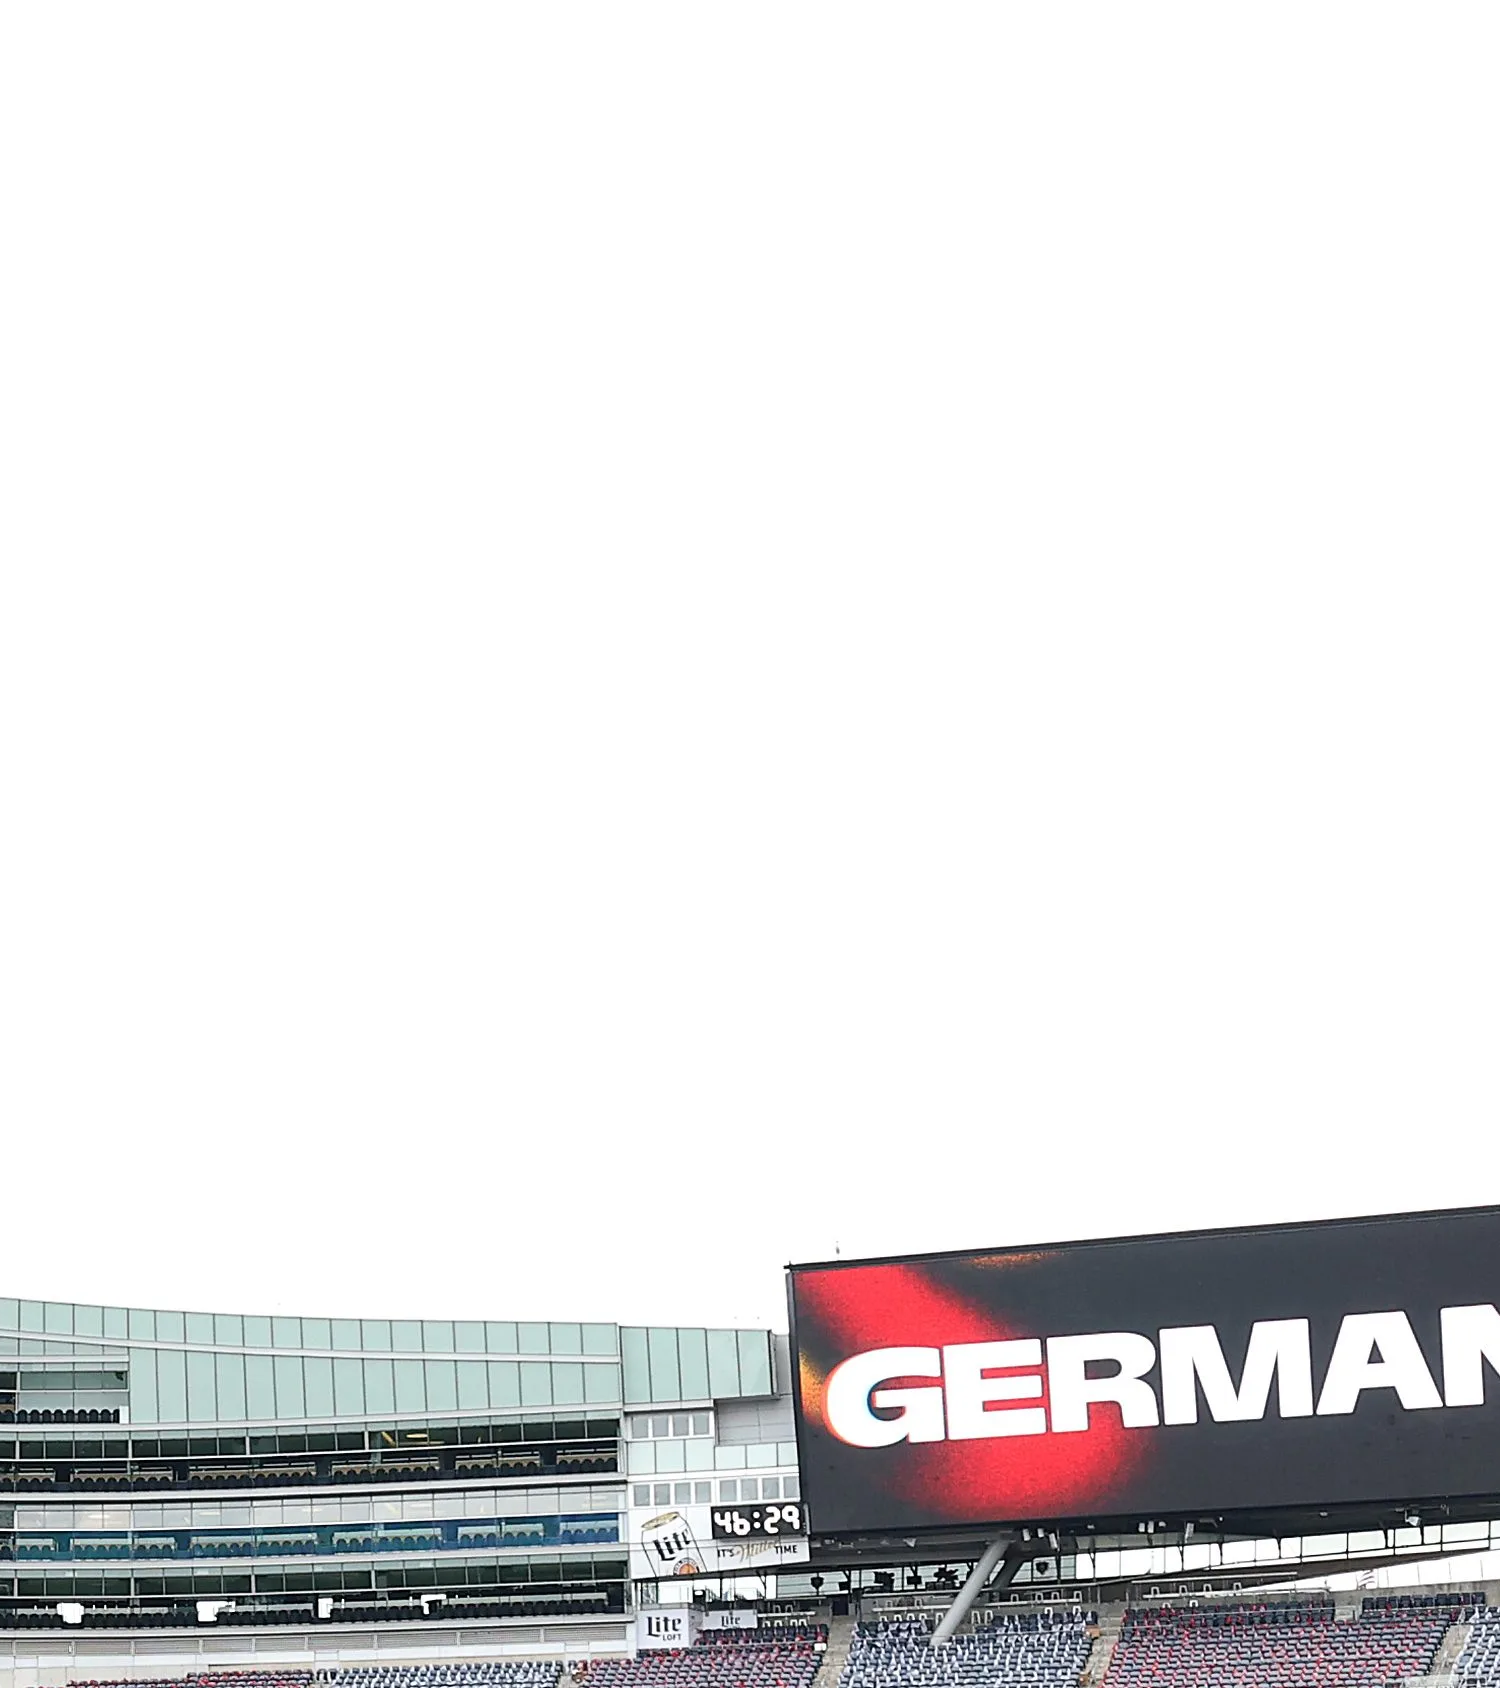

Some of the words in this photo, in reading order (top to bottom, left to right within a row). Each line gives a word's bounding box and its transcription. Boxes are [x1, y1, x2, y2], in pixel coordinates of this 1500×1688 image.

[714, 1504, 801, 1536] 46:29
[654, 1529, 691, 1562] Lite
[717, 1547, 734, 1558] IT'S
[775, 1544, 798, 1554] TIME
[647, 1615, 682, 1638] Lite
[721, 1615, 741, 1627] Lite
